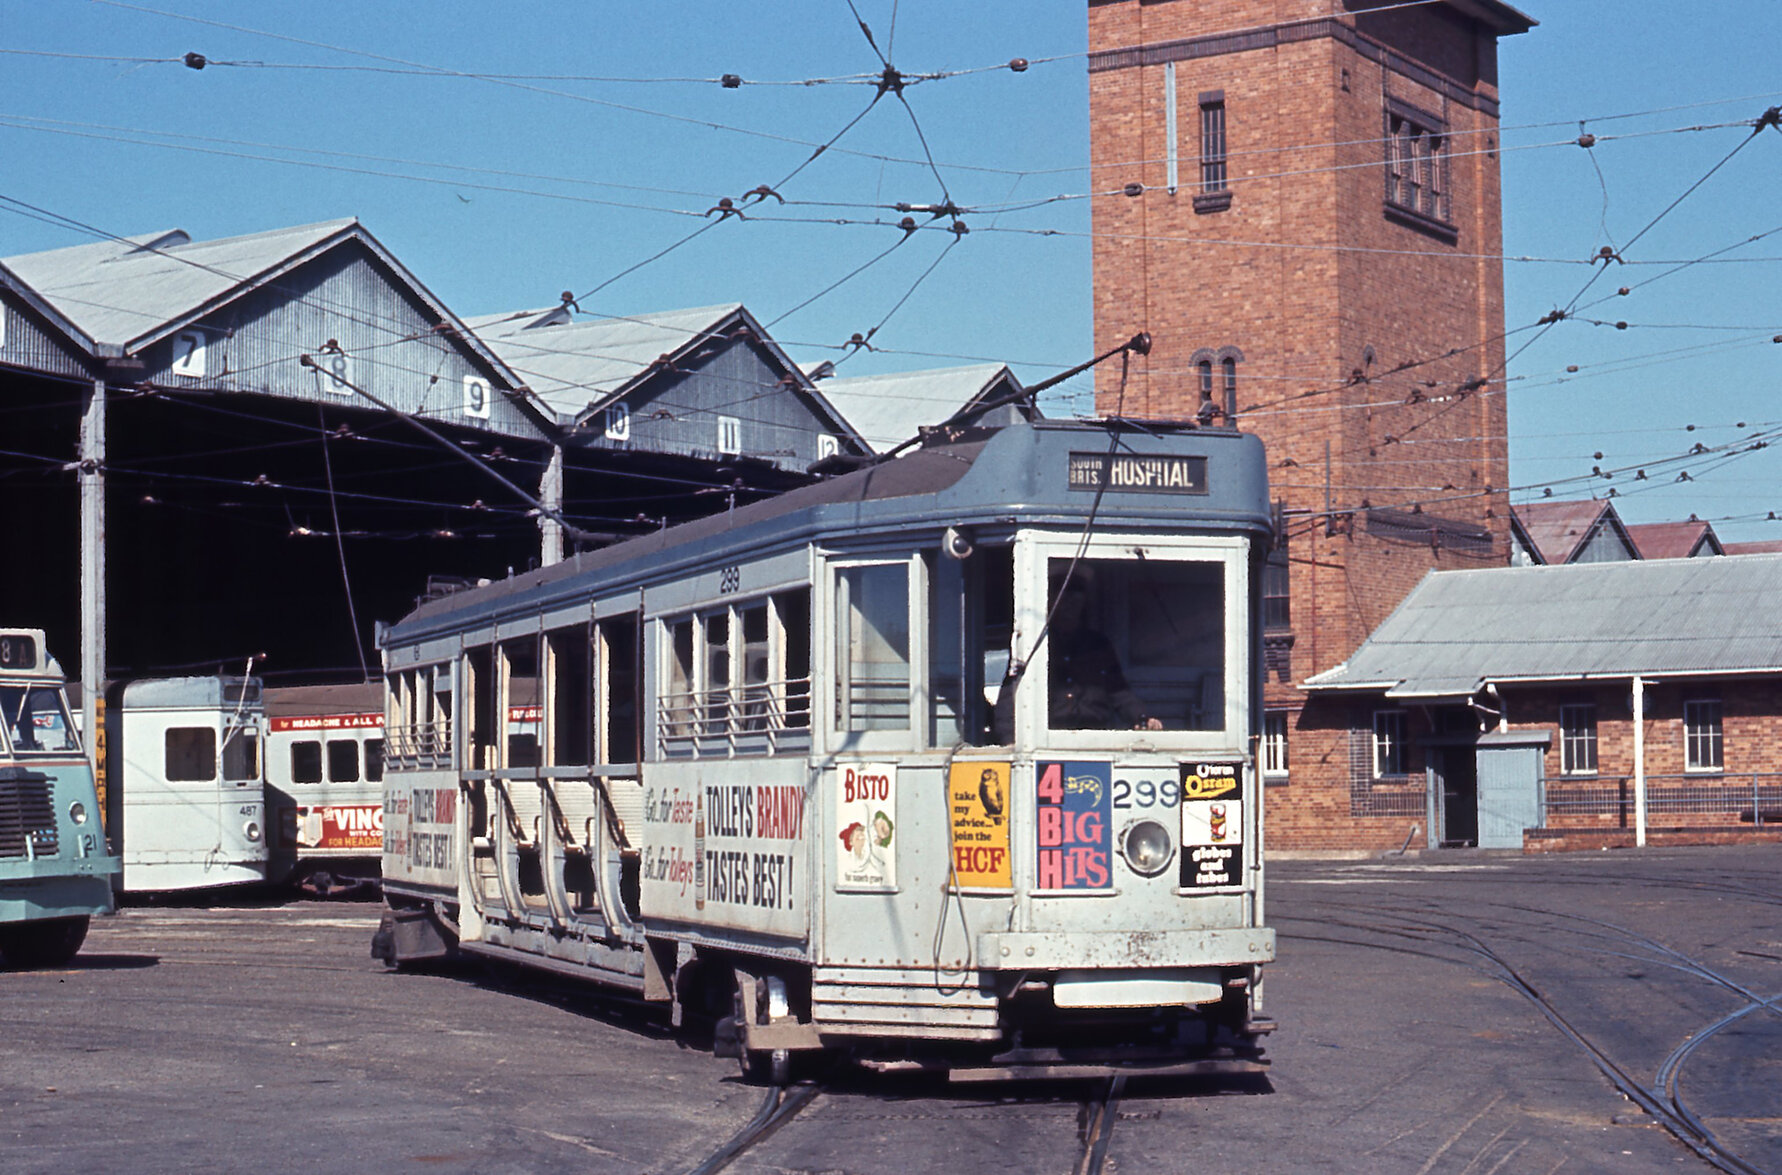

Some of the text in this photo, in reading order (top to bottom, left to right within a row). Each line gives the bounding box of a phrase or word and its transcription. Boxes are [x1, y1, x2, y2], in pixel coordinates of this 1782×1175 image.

[181, 335, 198, 368] 7
[332, 355, 347, 388] 8
[470, 381, 485, 412] 9
[608, 404, 627, 436] 10
[724, 423, 736, 450] 11
[1111, 459, 1193, 487] HOSPITAL
[720, 566, 740, 594] 299
[292, 718, 340, 728] HEADACHE
[352, 717, 373, 726] ALL
[844, 768, 889, 803] BISTO
[954, 792, 976, 801] take
[1038, 763, 1064, 804] 4
[1114, 779, 1179, 809] 299
[239, 806, 257, 817] 487
[706, 785, 807, 841] TOLLEYS BRANDY
[954, 806, 970, 815] my
[954, 832, 992, 843] join the
[1038, 806, 1104, 847] BIG
[84, 834, 97, 851] 21
[328, 837, 343, 847] FOR
[1191, 846, 1233, 862] globes
[954, 846, 1005, 873] HCF
[1038, 847, 1109, 889] HITS
[1199, 858, 1224, 871] and
[706, 850, 749, 905] TASTES
[1195, 871, 1230, 884] tubes
